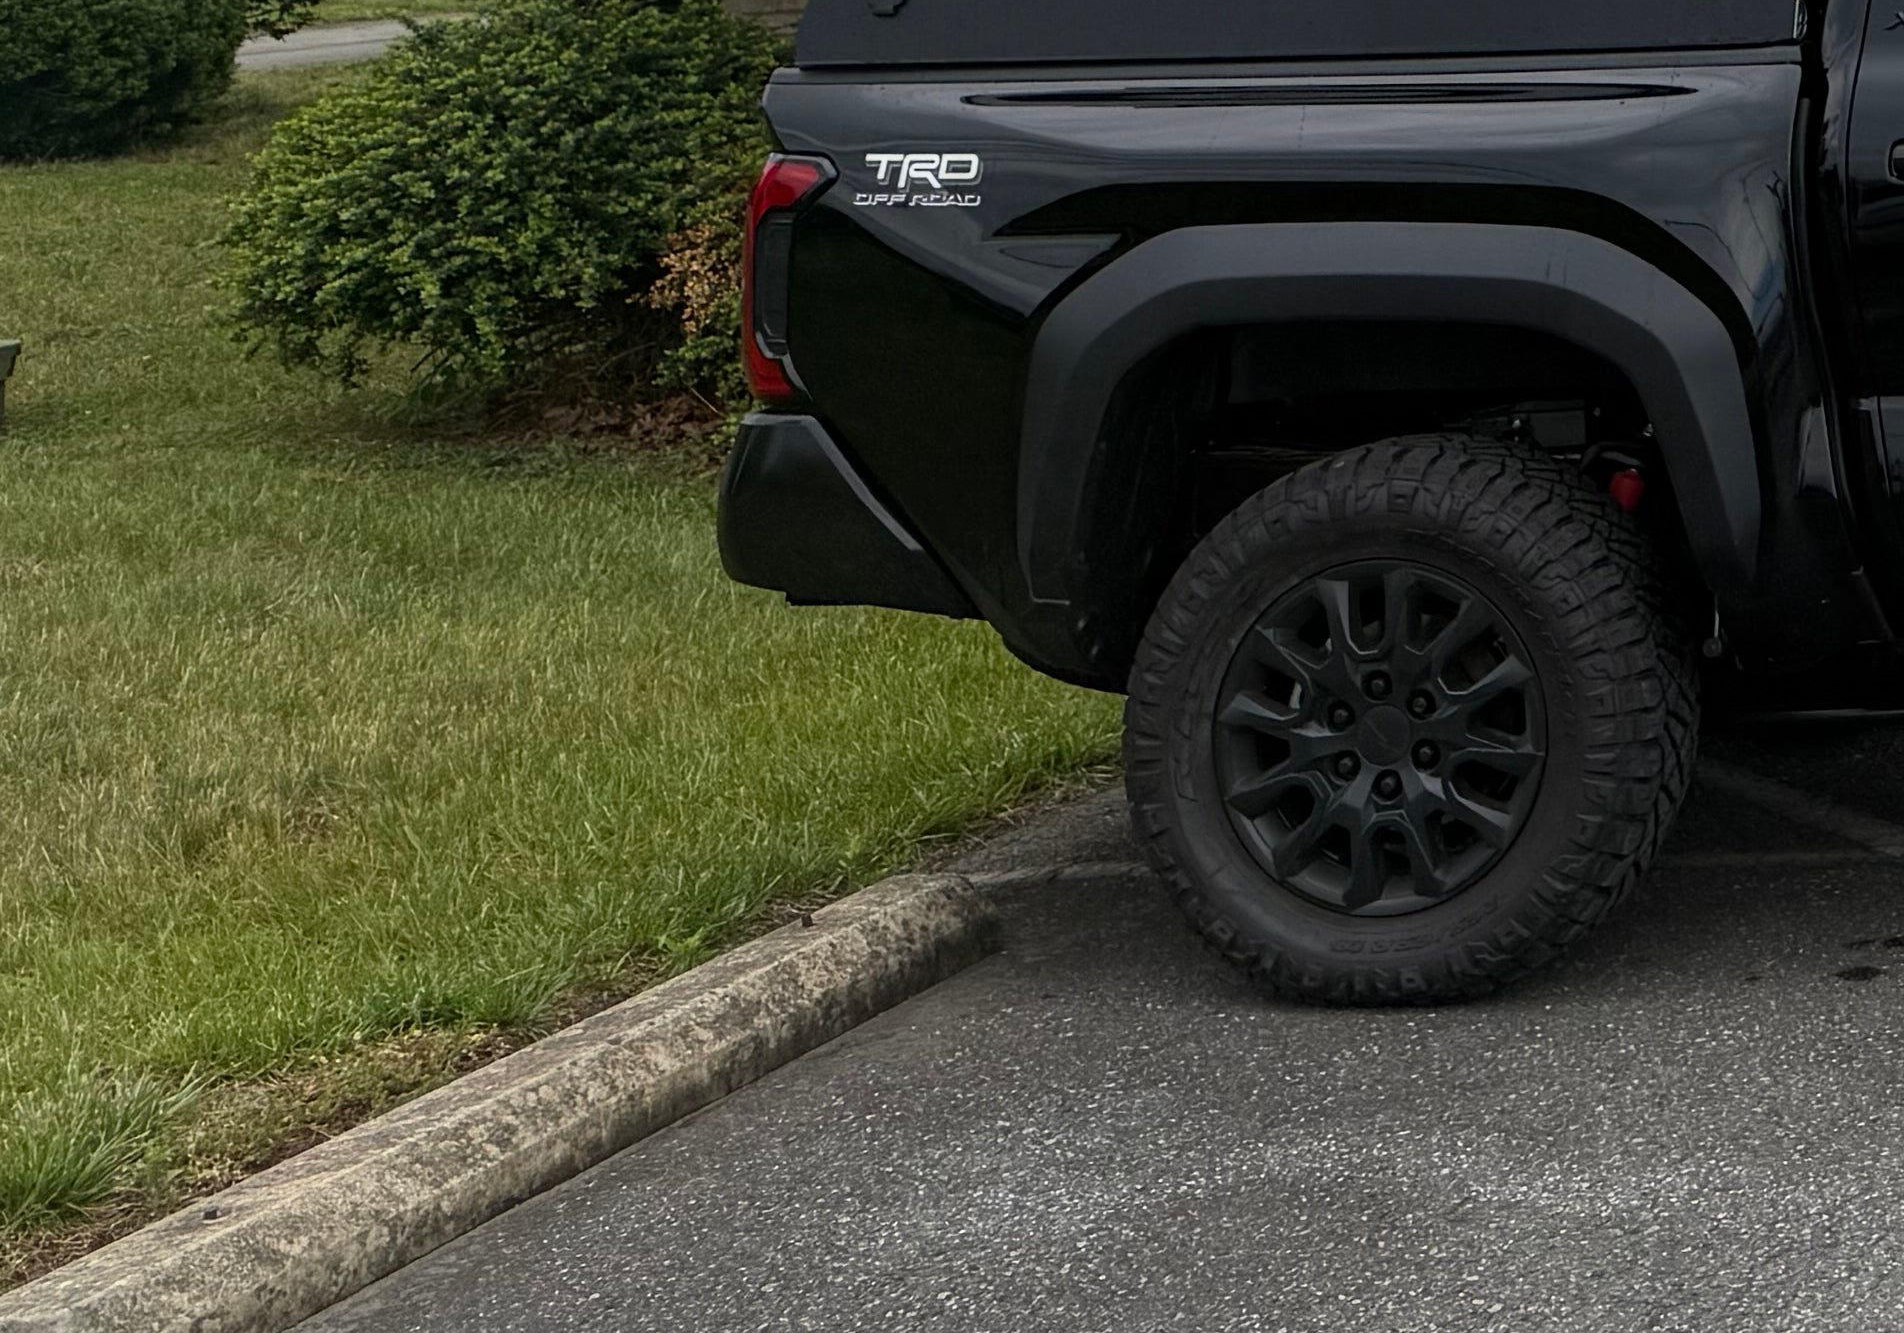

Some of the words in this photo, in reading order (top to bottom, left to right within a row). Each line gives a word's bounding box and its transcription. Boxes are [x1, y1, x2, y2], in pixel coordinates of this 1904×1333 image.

[865, 153, 983, 192] TRD
[853, 193, 906, 206] OFF
[908, 193, 982, 207] ROAD
